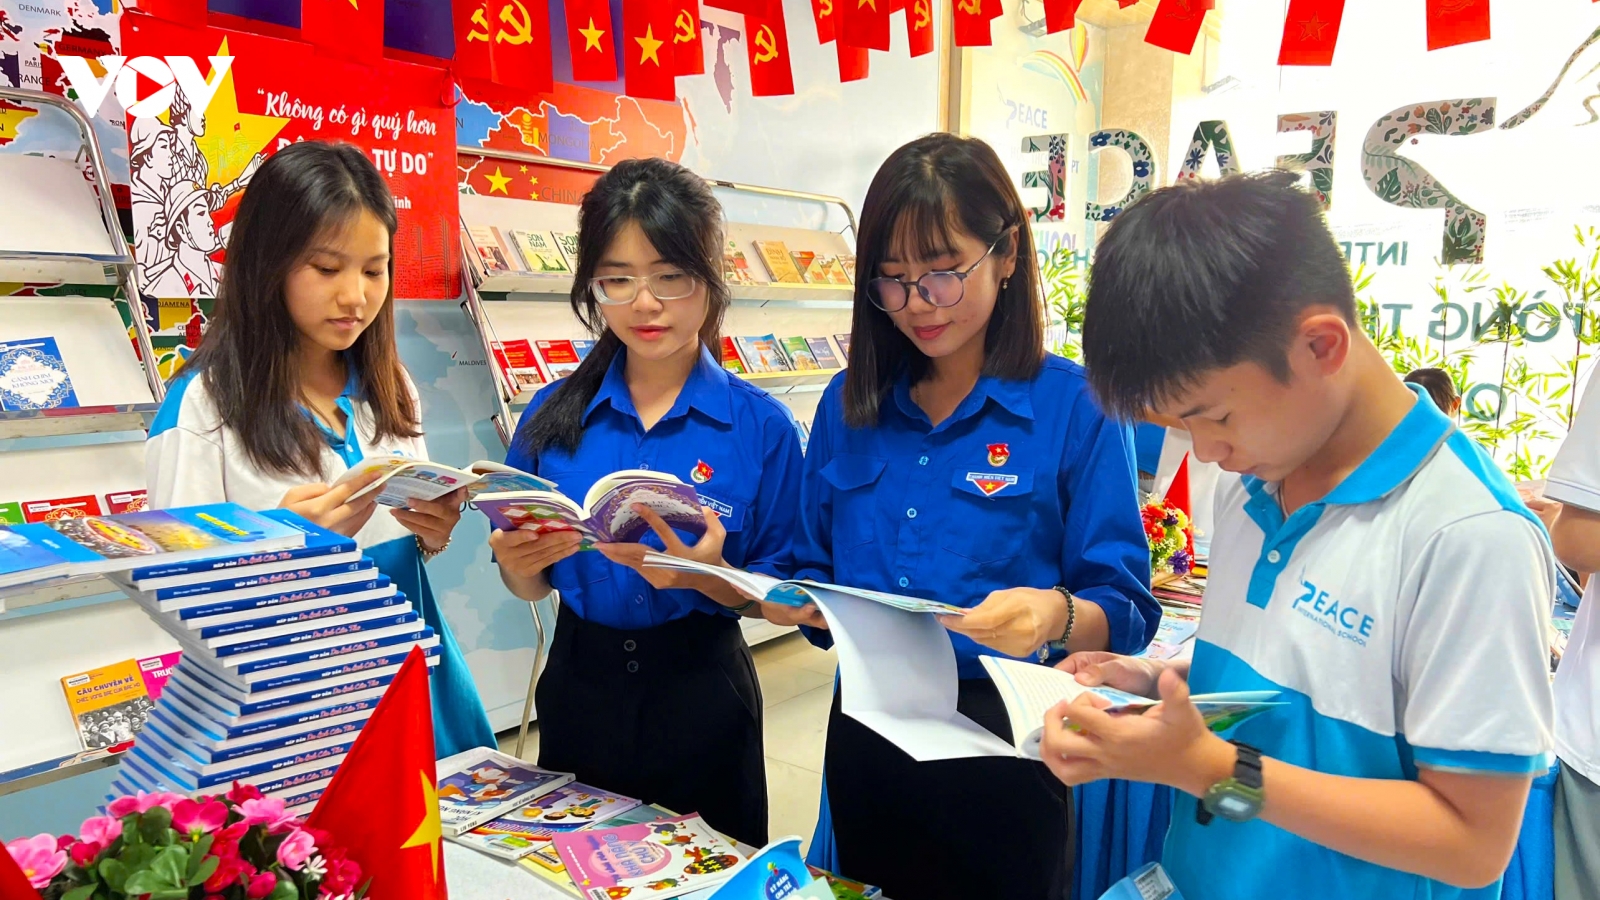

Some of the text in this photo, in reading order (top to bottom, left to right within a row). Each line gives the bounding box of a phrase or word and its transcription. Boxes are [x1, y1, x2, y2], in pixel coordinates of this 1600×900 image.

[18, 3, 62, 17] DENMARK
[58, 44, 106, 56] GERMANY
[18, 73, 51, 86] RANCE
[328, 104, 349, 124] có
[351, 107, 368, 136] gì
[371, 112, 402, 141] quý
[406, 109, 437, 136] hơn
[538, 132, 597, 150] MONGOLIA
[391, 195, 412, 209] inh
[1292, 580, 1375, 638] PEACE
[1337, 630, 1367, 648] SCHOOL
